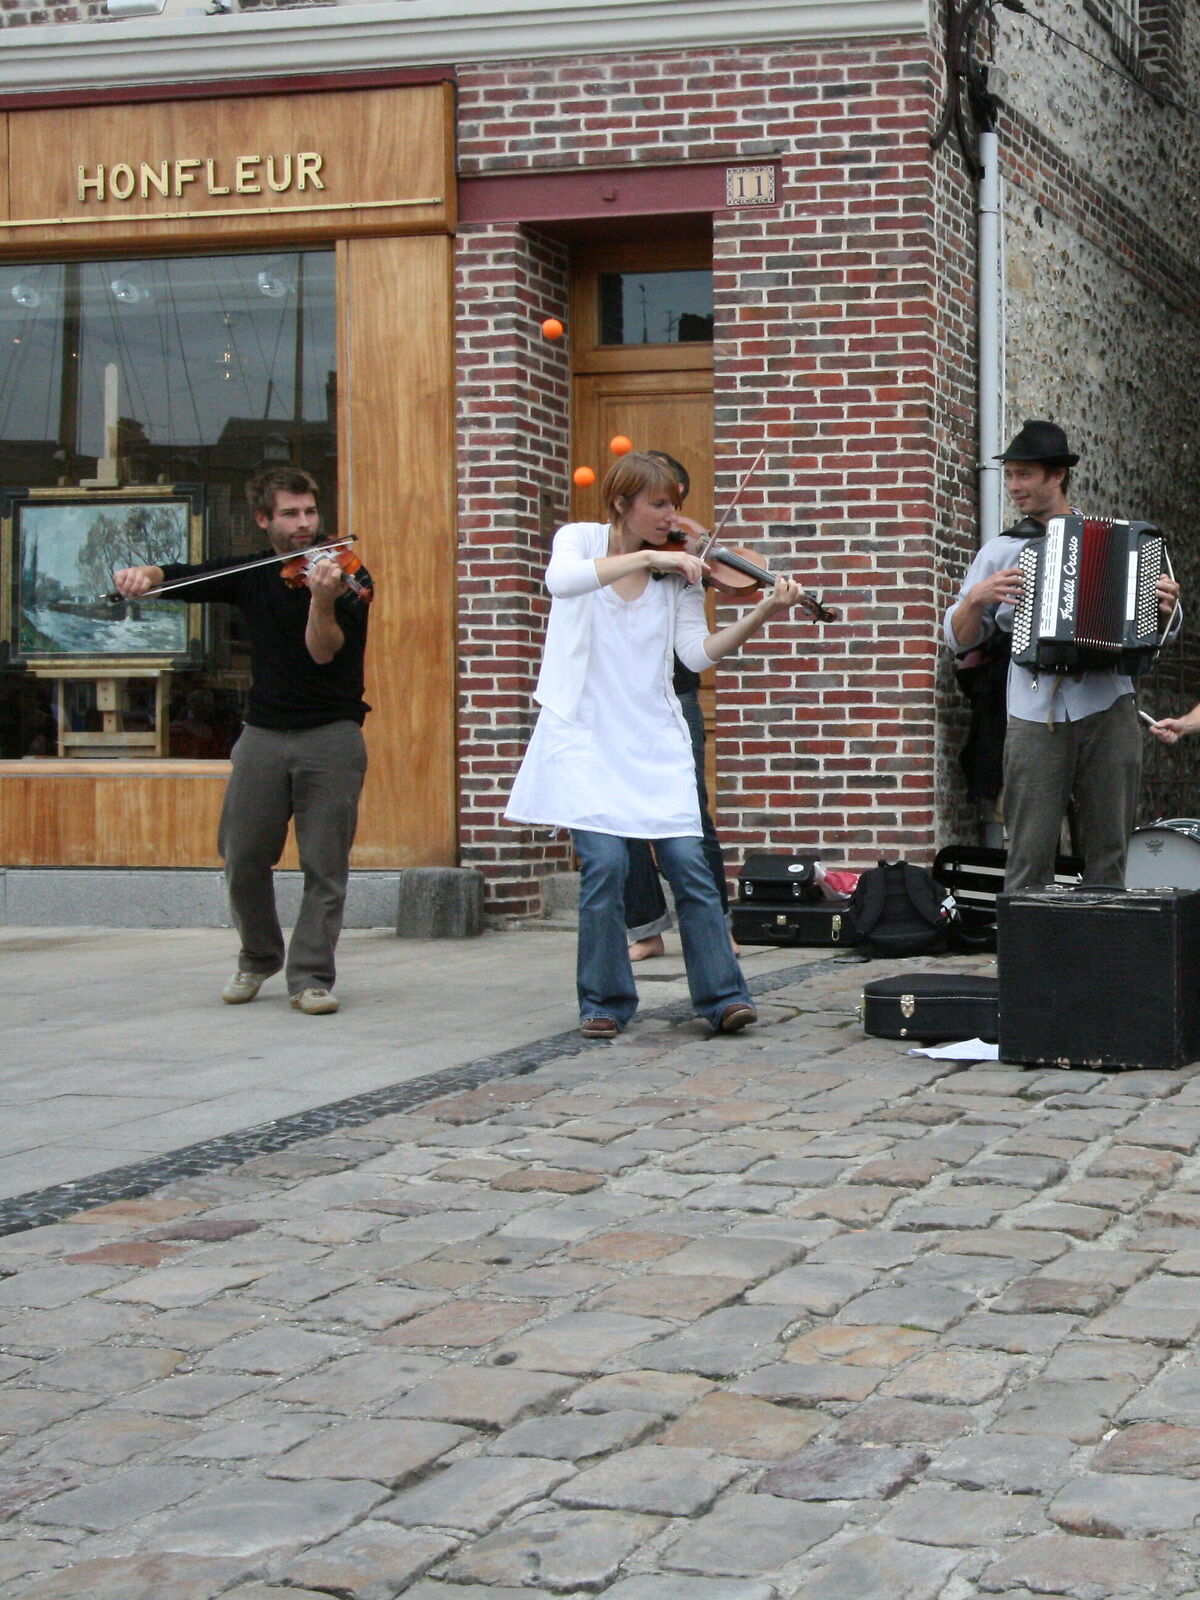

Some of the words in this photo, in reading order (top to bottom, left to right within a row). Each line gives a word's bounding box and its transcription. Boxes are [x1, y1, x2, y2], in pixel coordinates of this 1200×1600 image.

[78, 152, 325, 201] HONFLEUR
[738, 175, 763, 197] 11
[1063, 535, 1079, 576] Crosio
[1059, 578, 1075, 621] Fratelli
